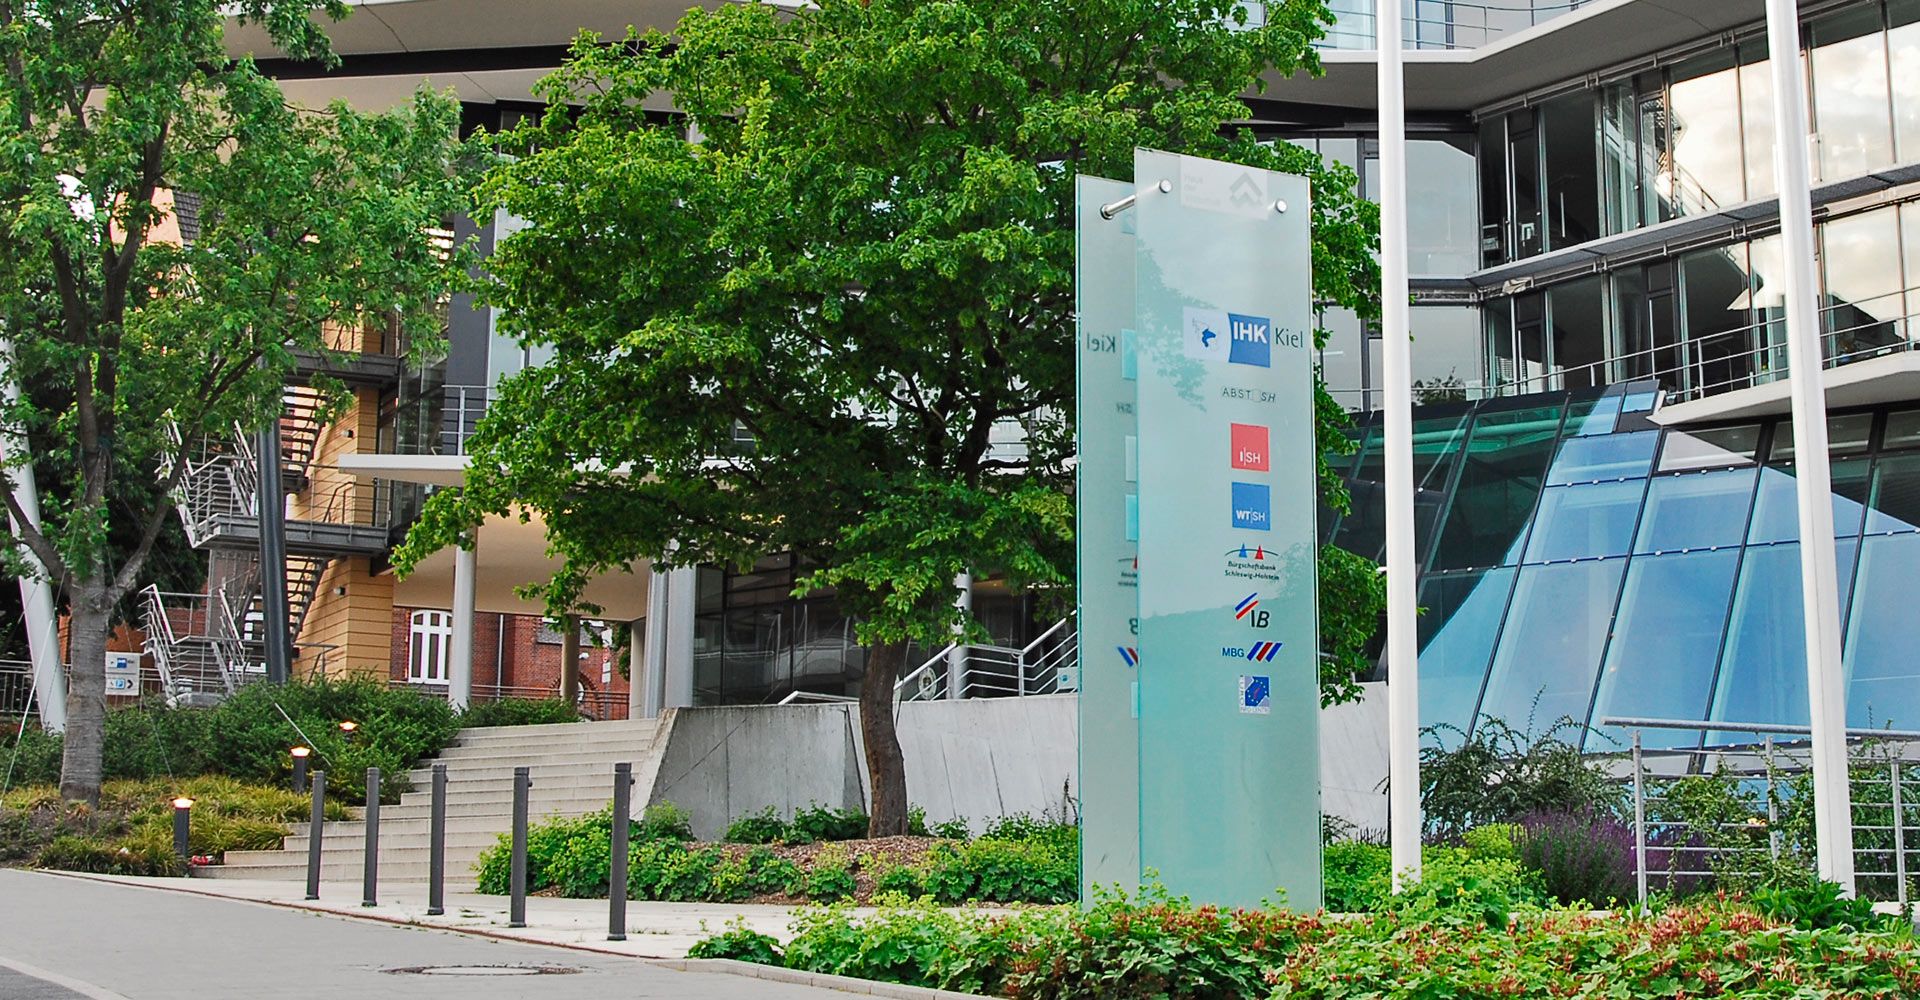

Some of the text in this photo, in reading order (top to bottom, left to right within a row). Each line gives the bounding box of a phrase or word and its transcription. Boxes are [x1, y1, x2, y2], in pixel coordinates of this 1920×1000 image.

[1233, 320, 1304, 349] IHK Kiel
[1224, 569, 1280, 581] Schleswig-Holstein
[1250, 609, 1270, 629] IB
[1222, 647, 1245, 658] MBG
